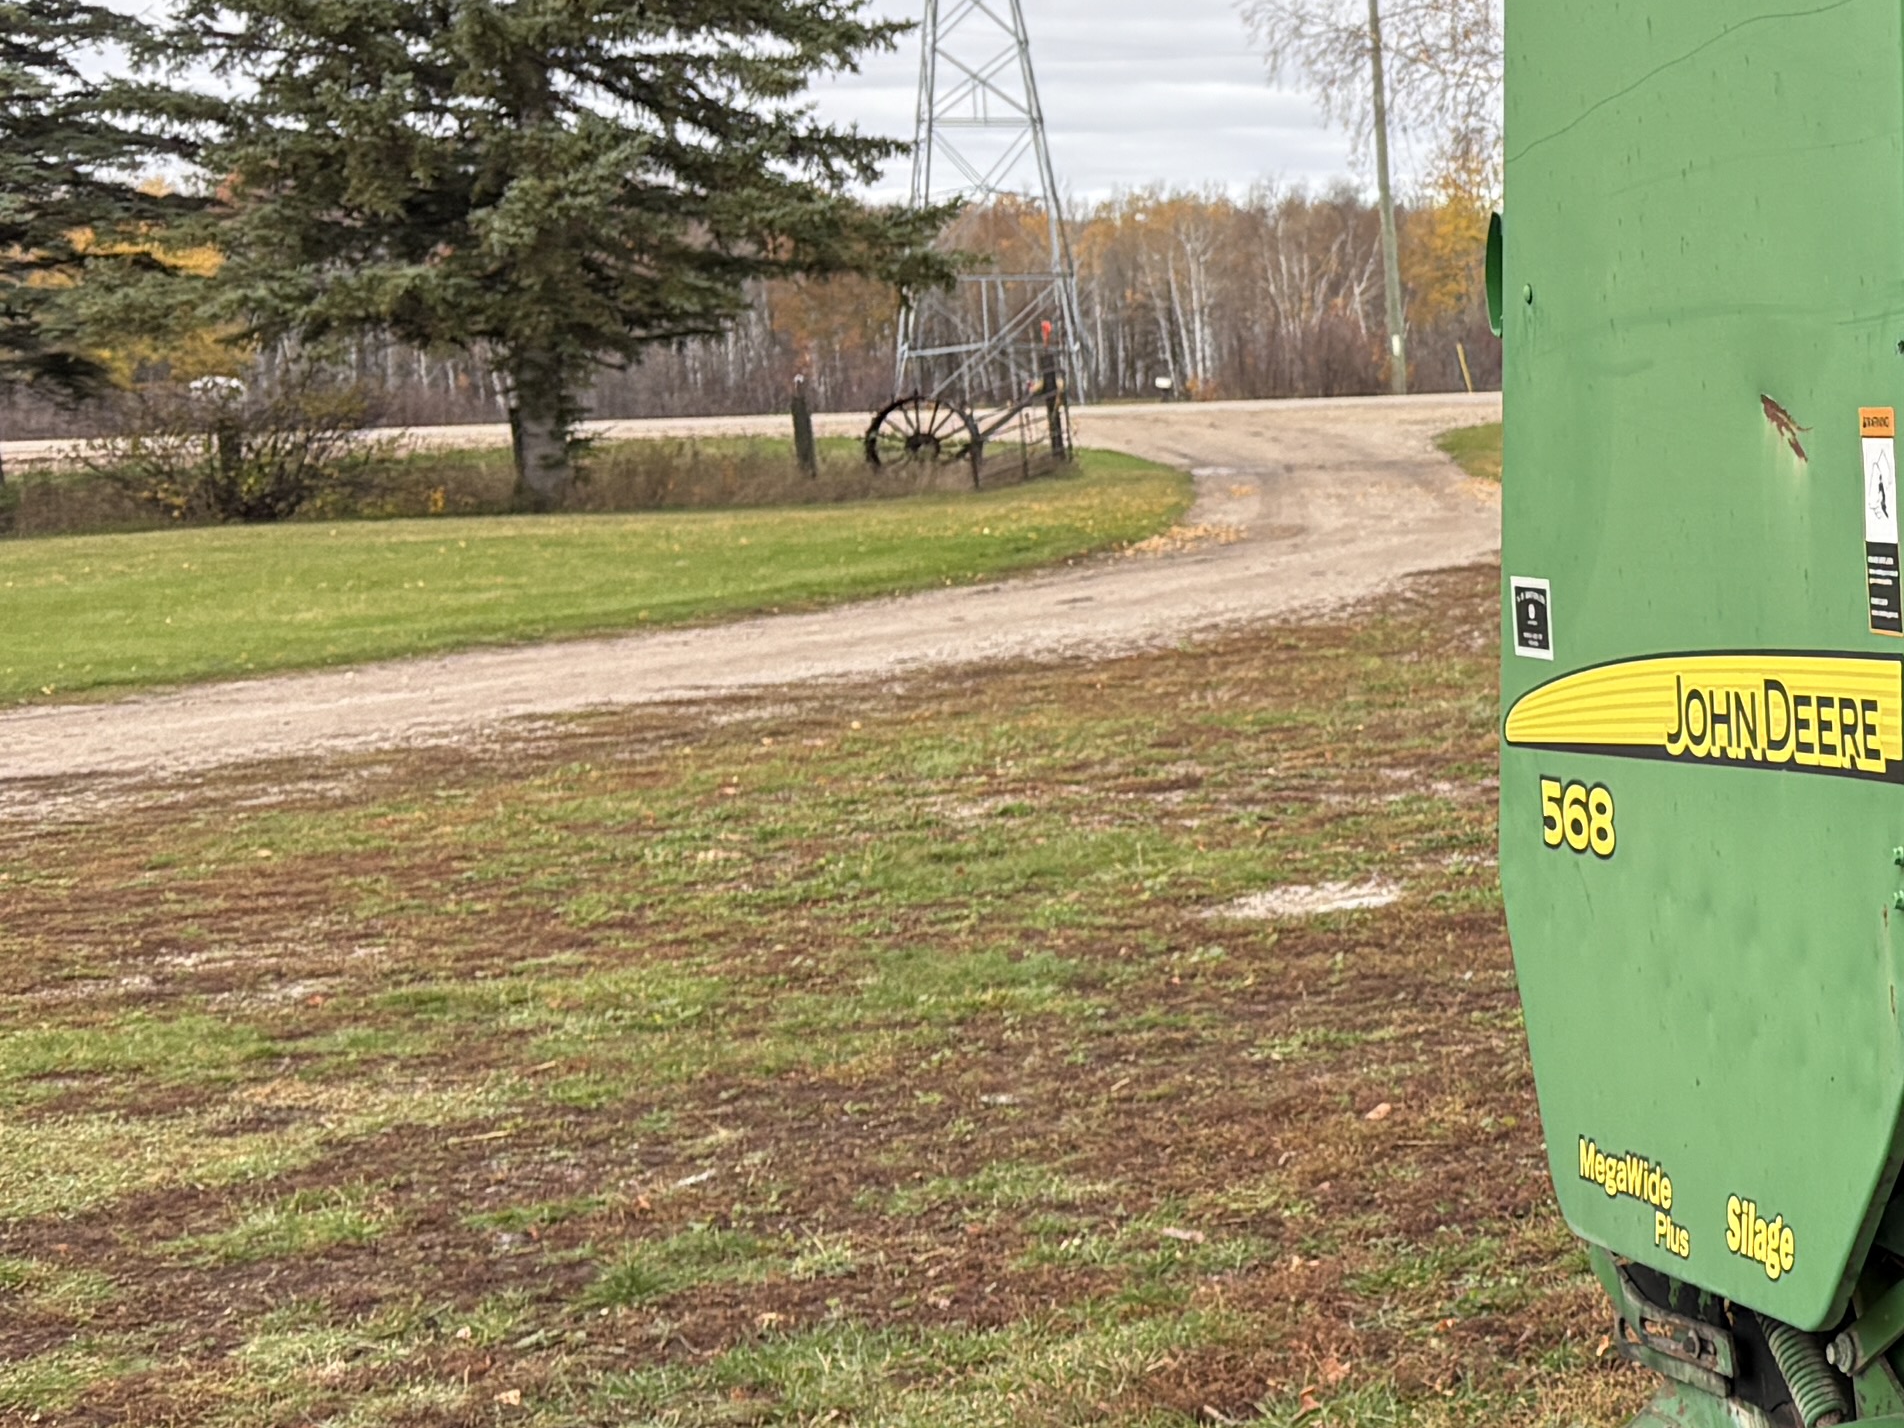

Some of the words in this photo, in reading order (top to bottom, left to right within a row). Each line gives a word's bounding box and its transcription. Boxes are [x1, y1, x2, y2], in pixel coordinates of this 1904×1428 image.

[1666, 674, 1758, 750] JOHN
[1764, 678, 1882, 762] DEERE
[1541, 775, 1616, 859] 568
[1578, 1135, 1673, 1210] MegaWide
[1655, 1210, 1690, 1259] Plus
[1726, 1193, 1795, 1280] Silage
